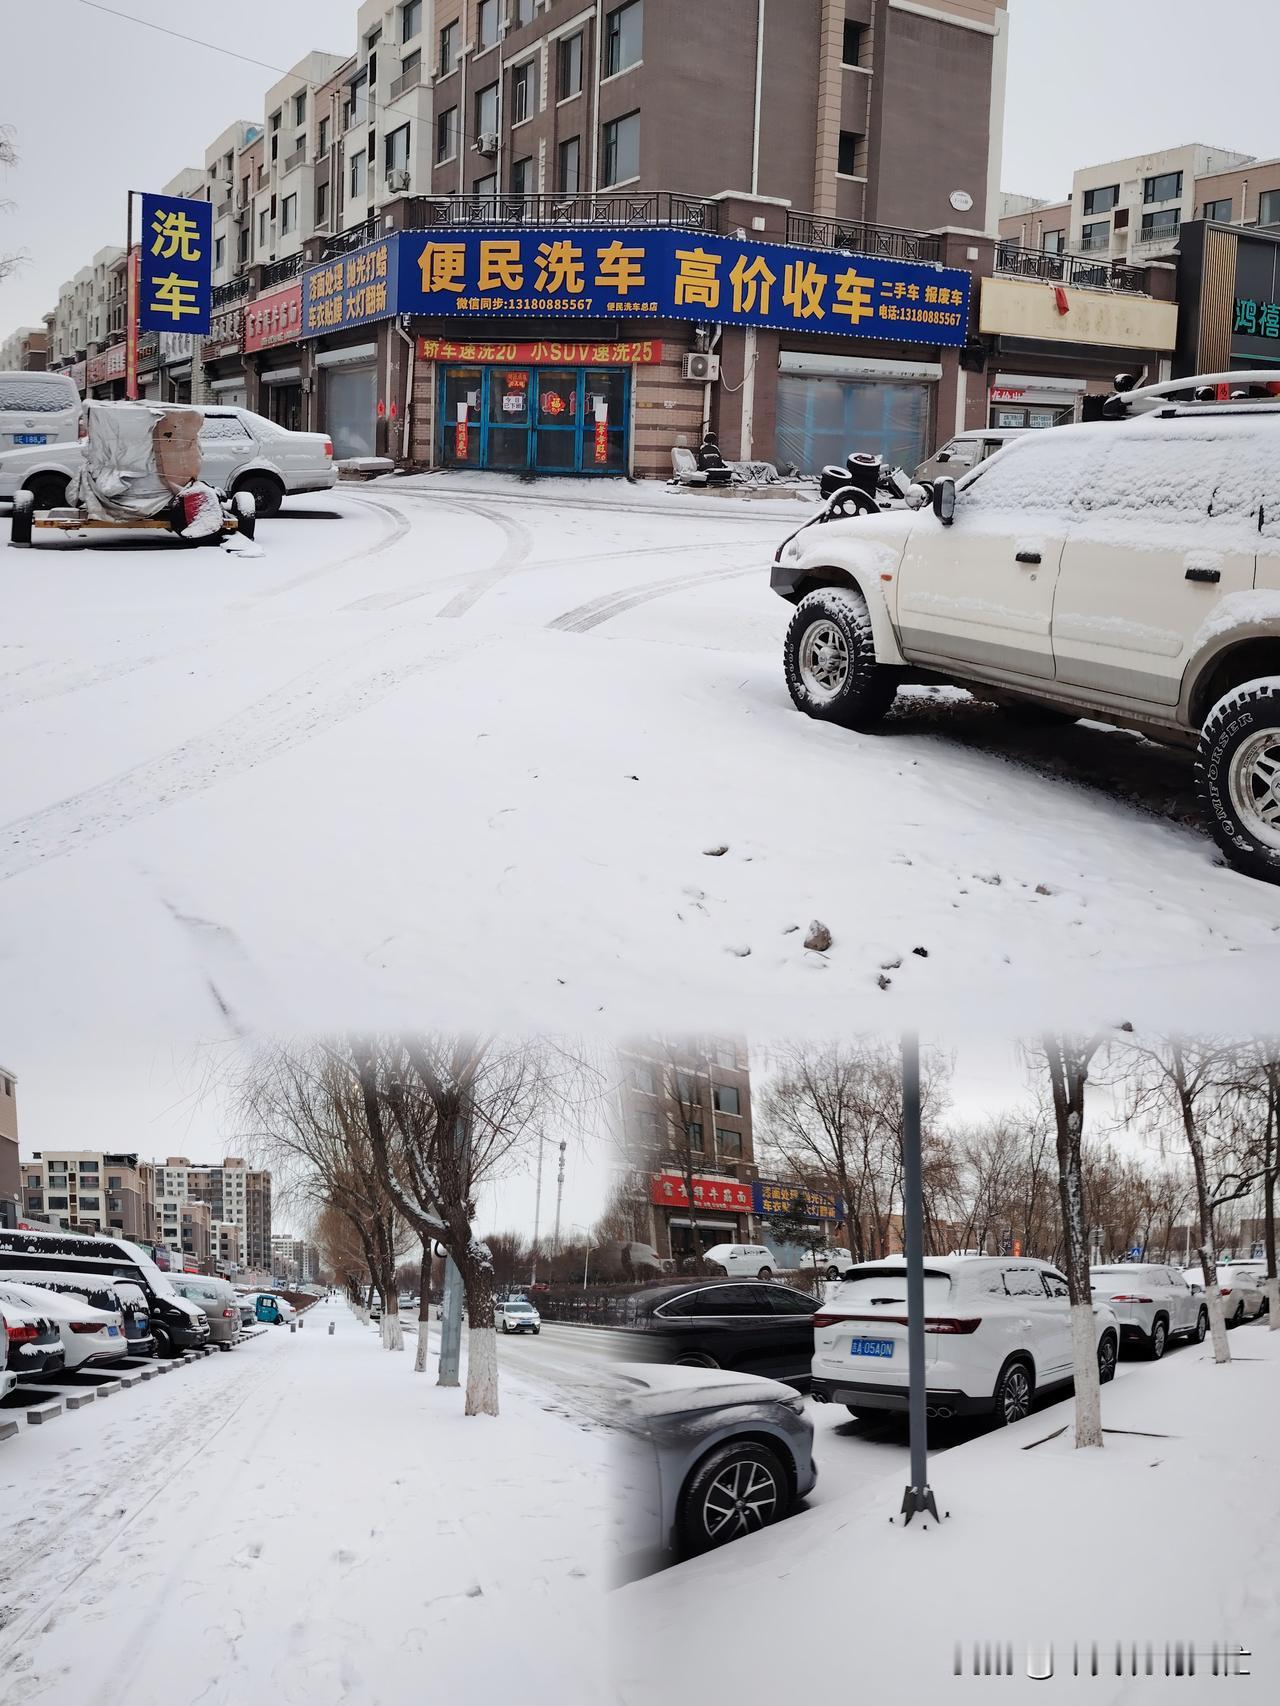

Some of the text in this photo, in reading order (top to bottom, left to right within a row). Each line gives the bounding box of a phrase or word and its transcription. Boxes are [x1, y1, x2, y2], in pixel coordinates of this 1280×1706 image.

[150, 209, 201, 320] 洗车
[417, 240, 645, 295] 便民洗车
[456, 297, 658, 311] 微信同步:13180885567 便民洗车总店
[674, 247, 875, 324] 高价收车
[880, 281, 963, 306] 二手车 报废车
[308, 281, 387, 330] 车衣贴膜 大灯翻新
[878, 303, 962, 327] 电话:13180885567
[424, 341, 653, 361] 轿车速洗20 小SUV速洗25
